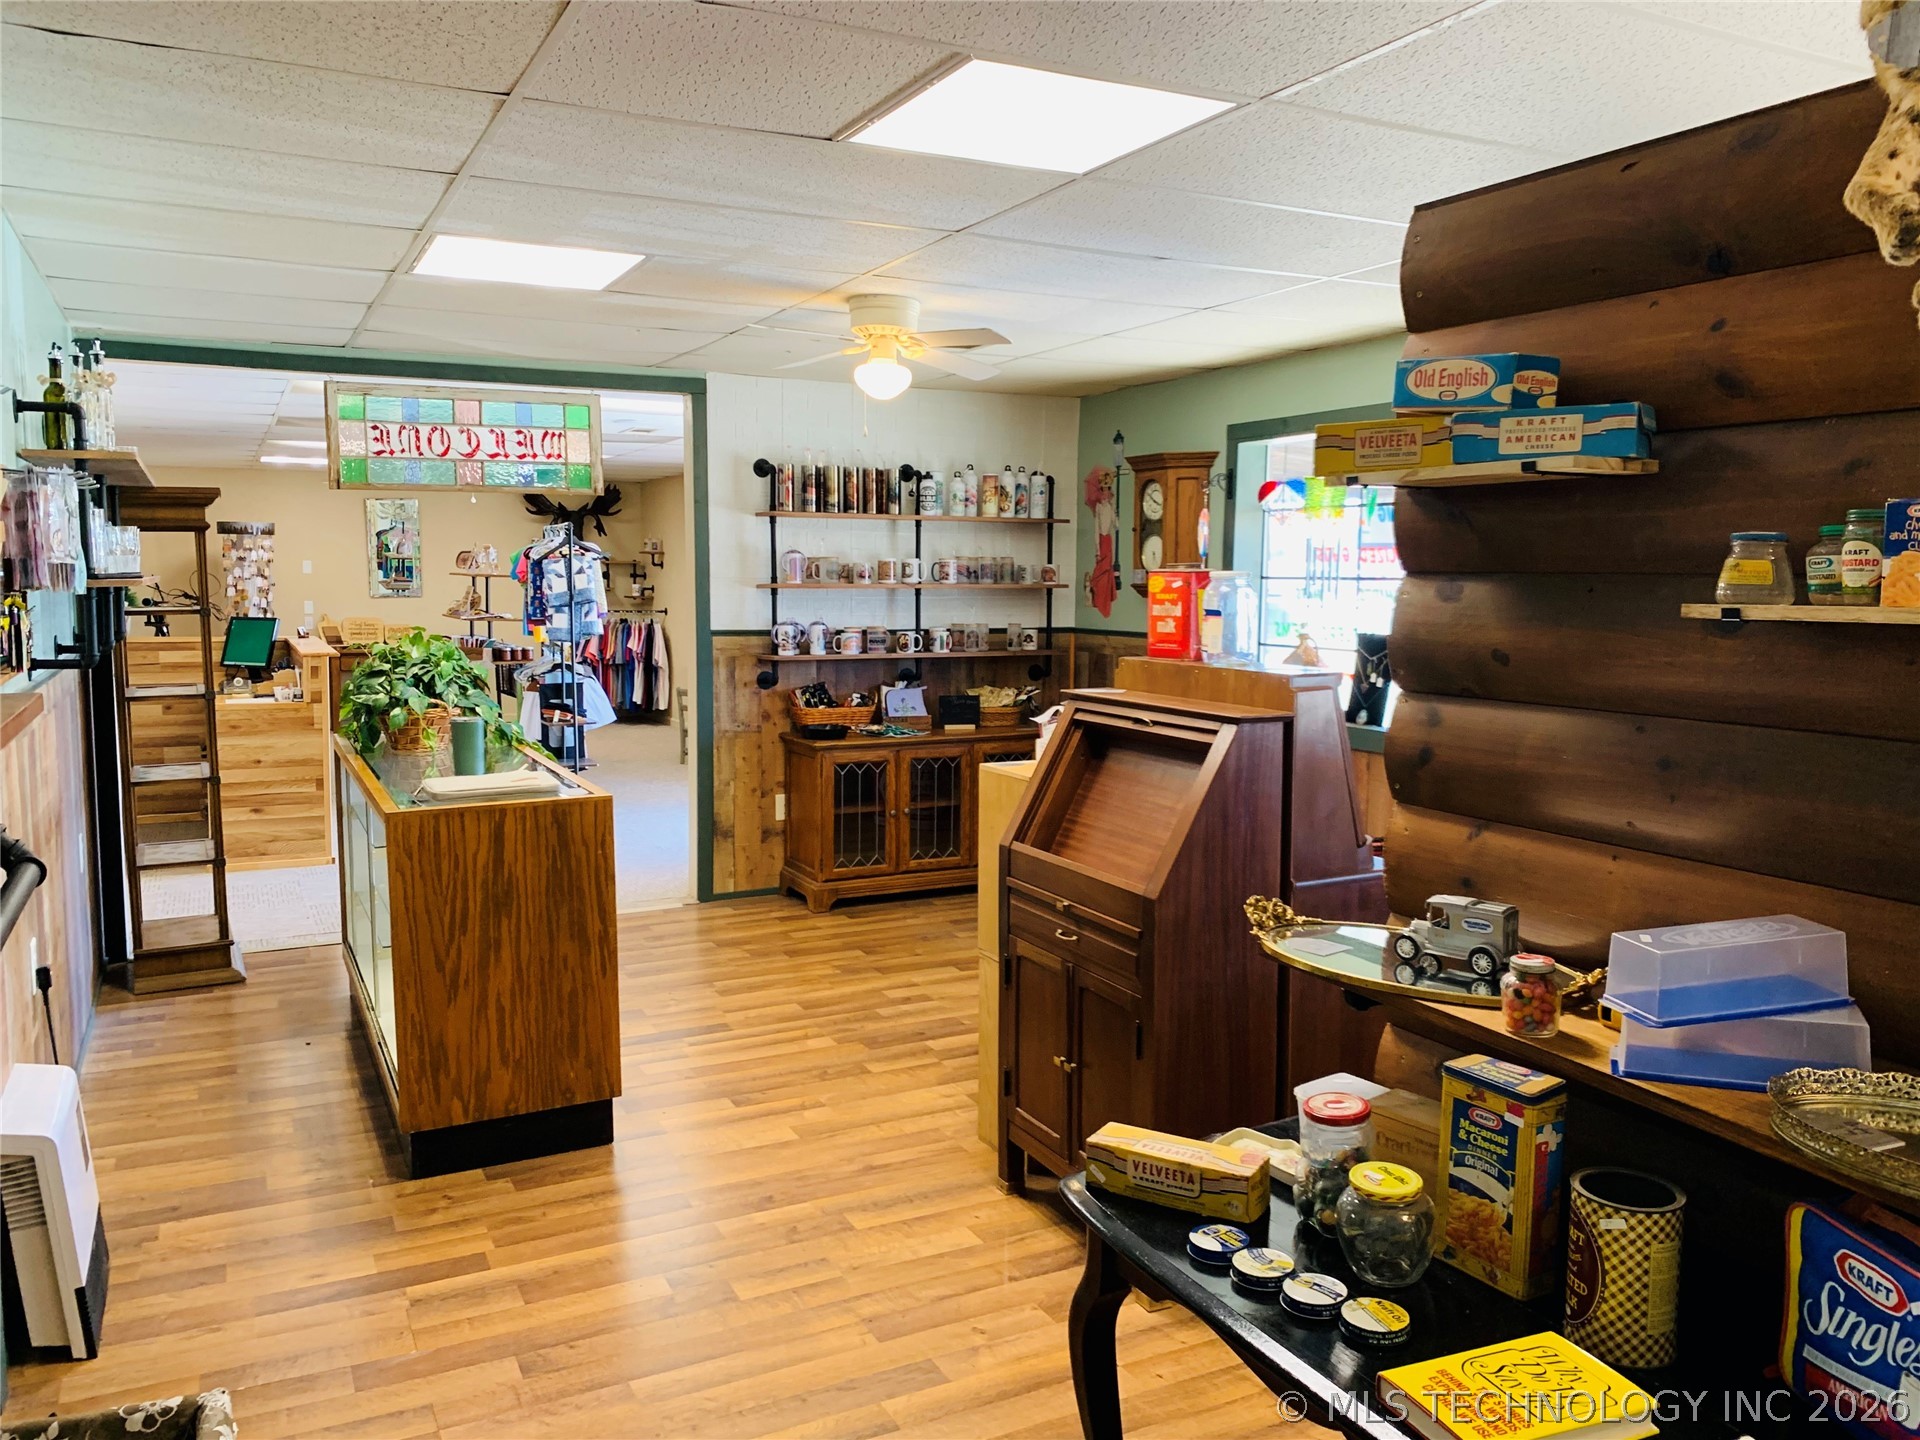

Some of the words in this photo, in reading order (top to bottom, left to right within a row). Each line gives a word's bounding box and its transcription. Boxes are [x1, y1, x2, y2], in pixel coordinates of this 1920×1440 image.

[1413, 369, 1436, 389] Old
[1438, 366, 1489, 391] English
[1516, 374, 1529, 385] Old
[1530, 376, 1556, 388] English
[1516, 416, 1567, 427] KRAFT
[1359, 432, 1418, 450] VELVEETA
[1505, 433, 1577, 443] AMERICAN
[1889, 529, 1908, 541] and
[1475, 1112, 1496, 1125] KRAFT
[1458, 1118, 1509, 1146] Macaroni
[1458, 1128, 1468, 1140] &
[1469, 1132, 1509, 1157] Cheese
[1132, 1159, 1195, 1185] VELVEETA
[1464, 1155, 1499, 1177] Original
[1138, 1176, 1165, 1186] KRAFT
[1165, 1183, 1195, 1193] product
[1847, 1262, 1894, 1302] KRAFT
[1375, 1300, 1392, 1316] Kraft
[1391, 1313, 1407, 1324] Oil
[1803, 1280, 1920, 1376] Singles
[1470, 1360, 1528, 1389] Say
[1510, 1357, 1552, 1383] Do
[1533, 1350, 1588, 1384] Why
[1436, 1368, 1471, 1392] BEHIND
[1471, 1424, 1496, 1440] USE
[1485, 1420, 1509, 1436] AND
